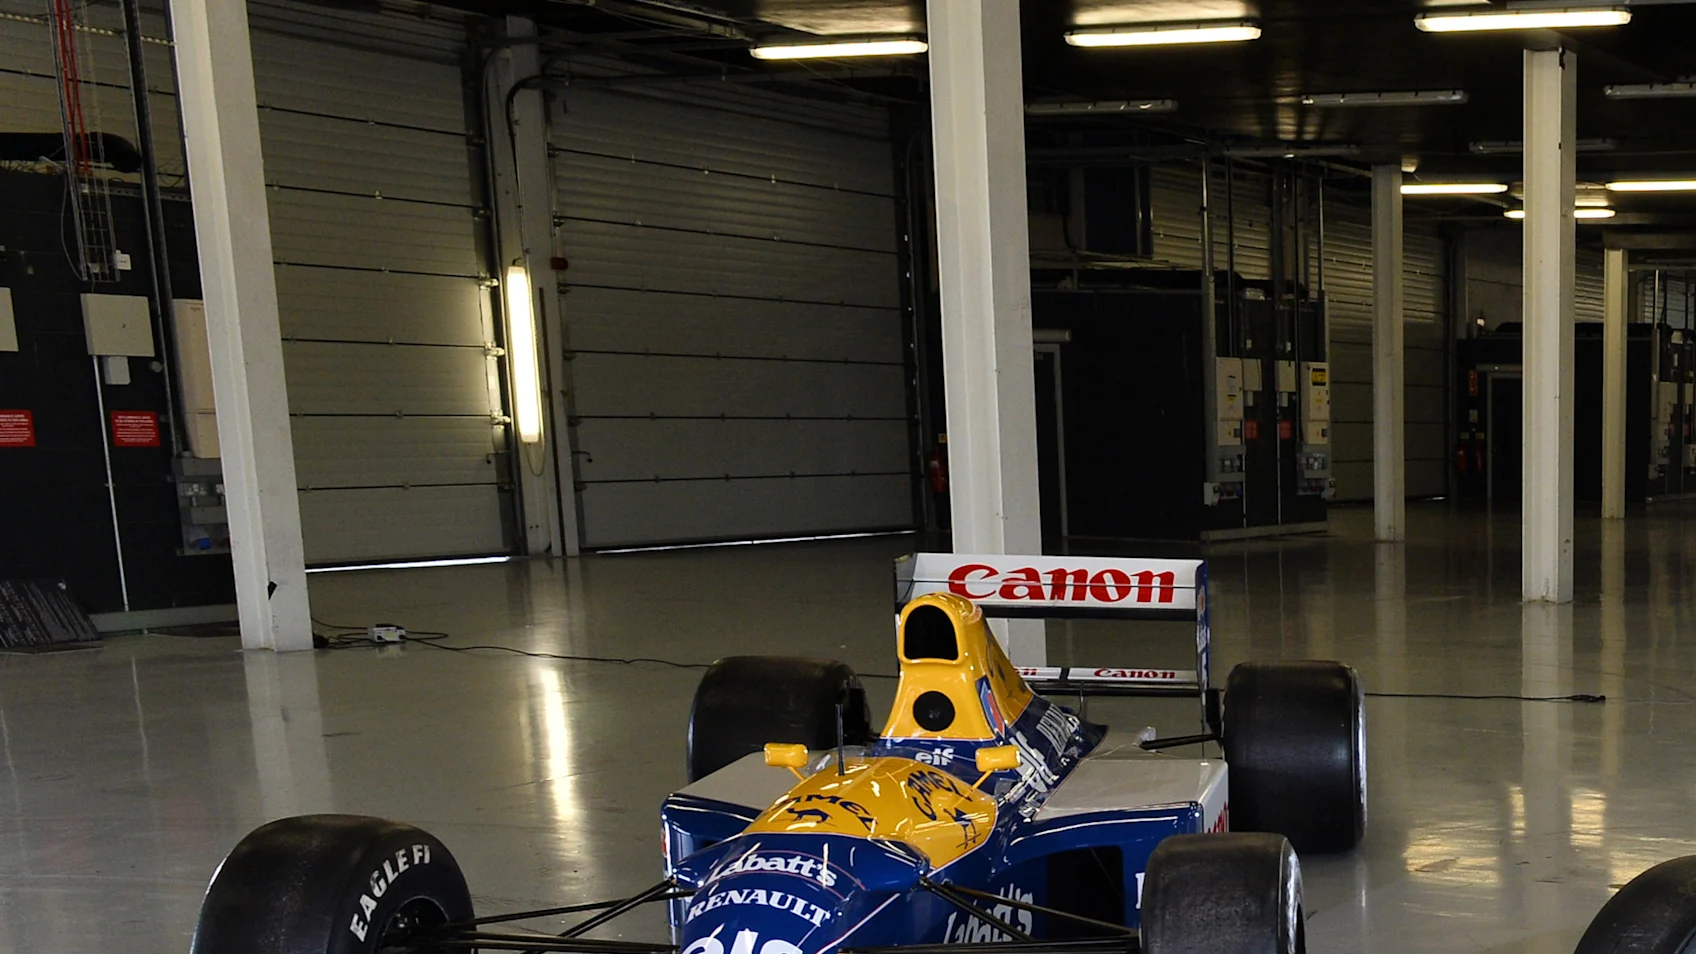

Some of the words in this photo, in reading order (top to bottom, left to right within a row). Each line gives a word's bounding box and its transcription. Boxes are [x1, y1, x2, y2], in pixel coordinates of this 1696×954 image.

[948, 564, 1175, 603] Canon
[1094, 668, 1175, 679] Canon
[915, 748, 955, 766] elf
[766, 795, 879, 832] AMEL
[907, 770, 973, 821] CAMEL
[707, 853, 838, 886] Labatt's
[350, 849, 410, 943] EAGLE
[686, 889, 832, 926] RENAULT
